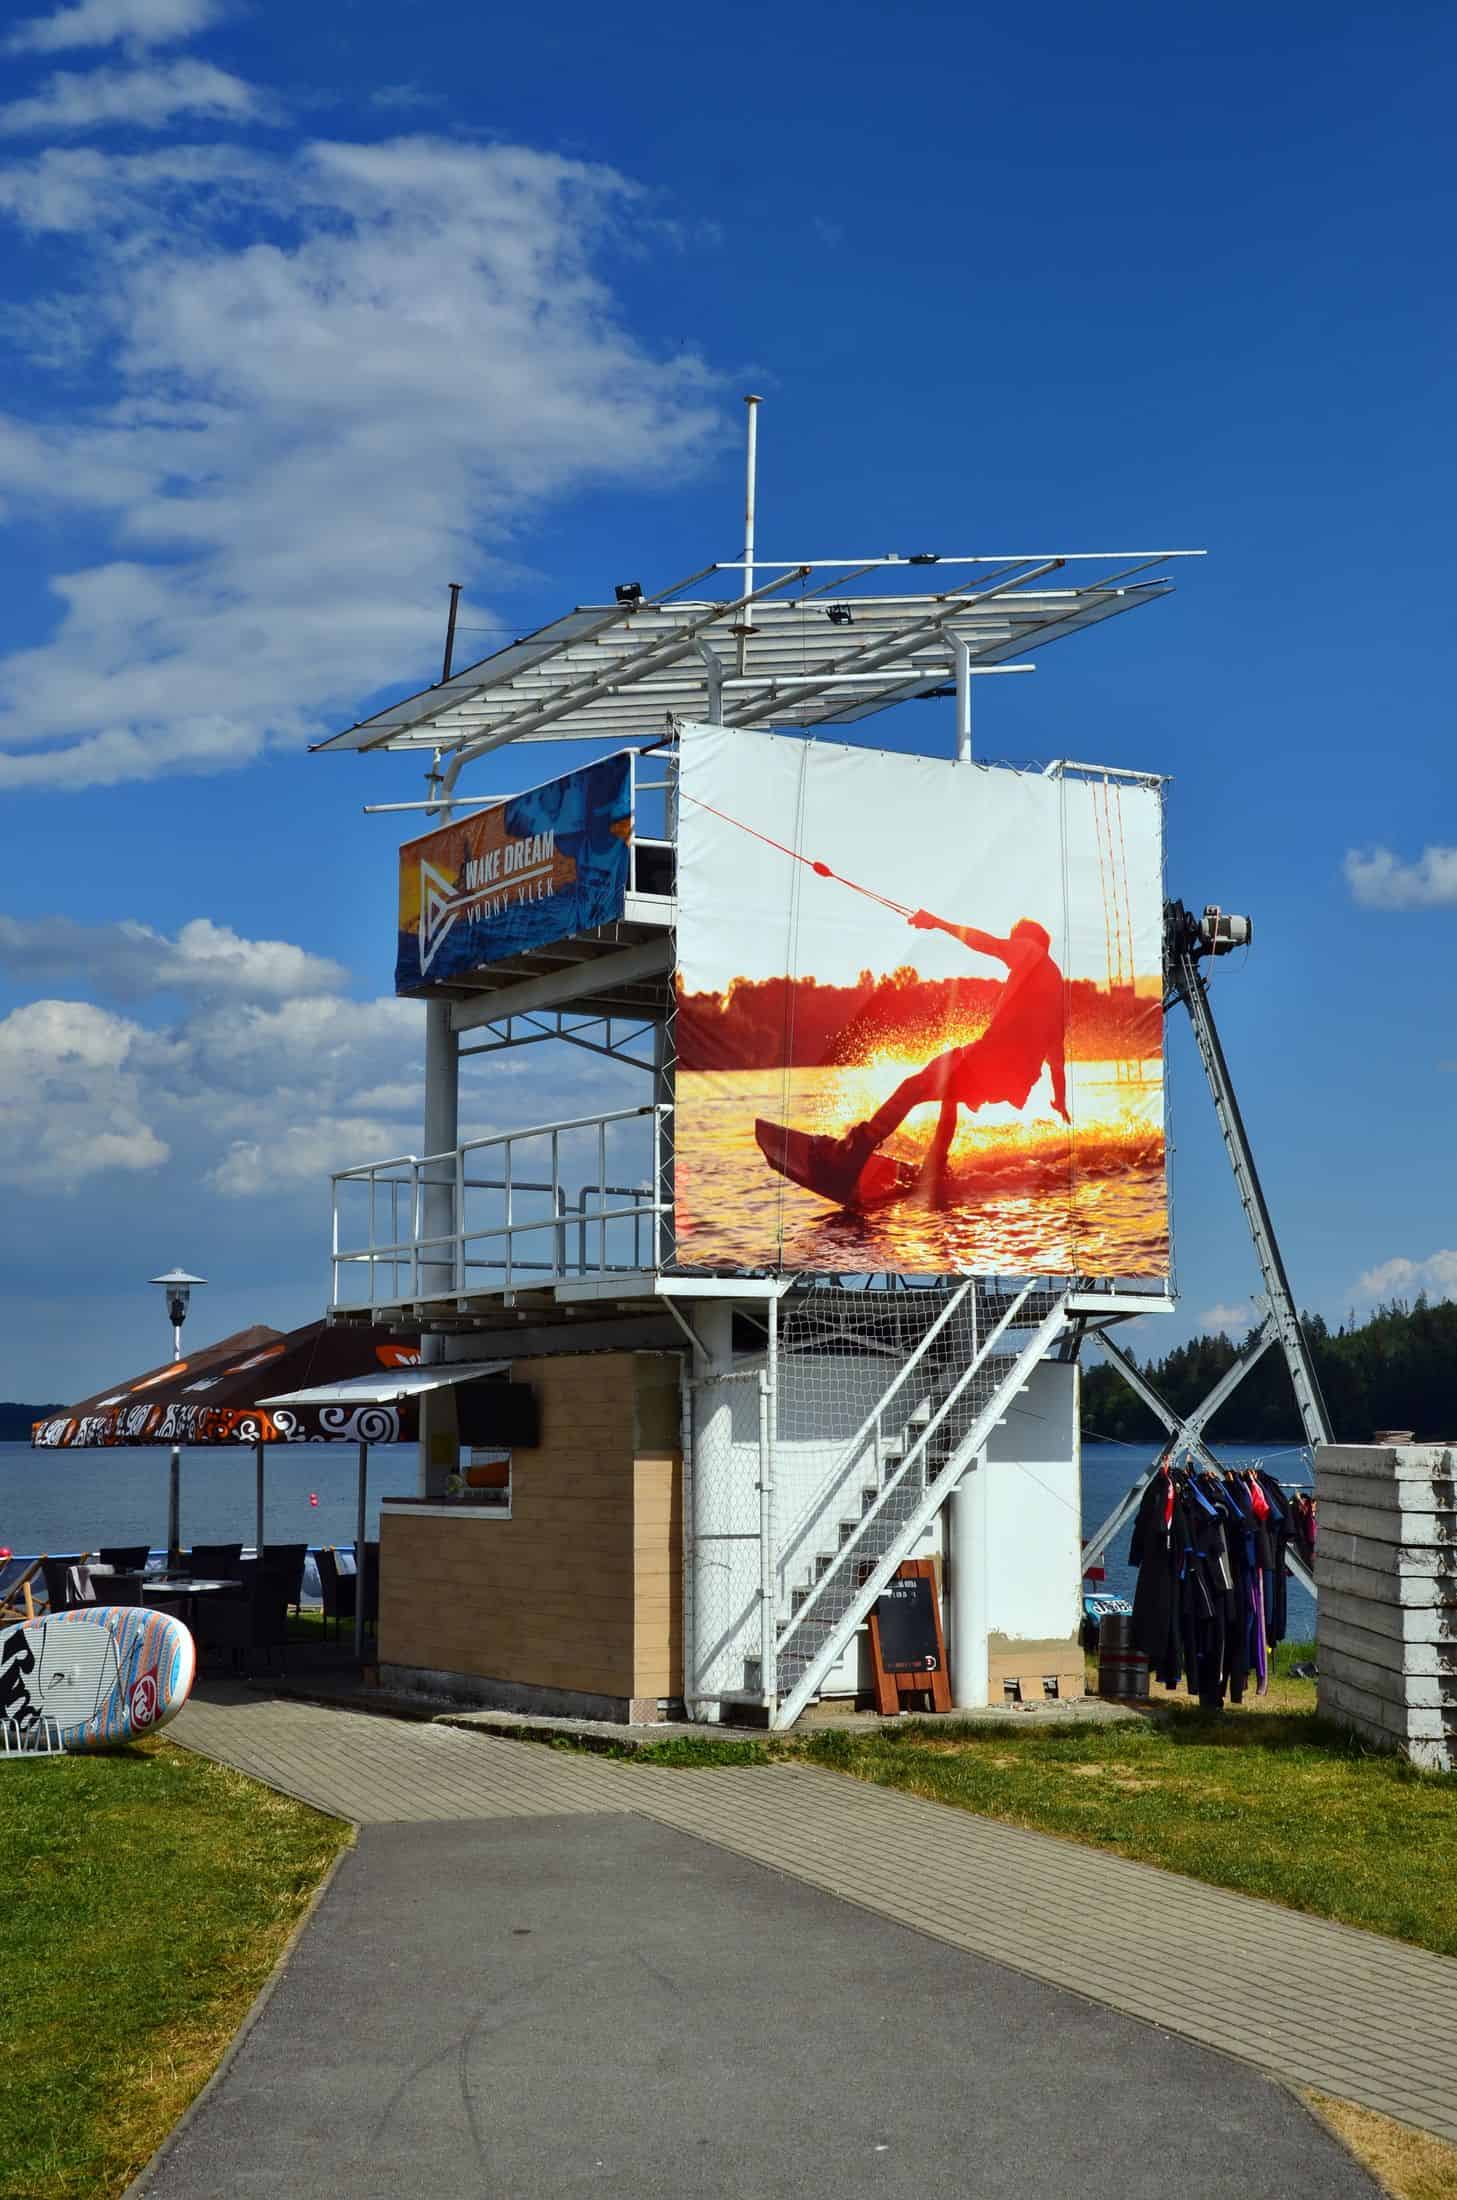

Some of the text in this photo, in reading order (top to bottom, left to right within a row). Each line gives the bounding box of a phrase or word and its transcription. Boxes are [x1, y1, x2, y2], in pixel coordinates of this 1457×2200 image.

[466, 827, 555, 890] WAKE DREAM
[518, 877, 555, 906] VLEK
